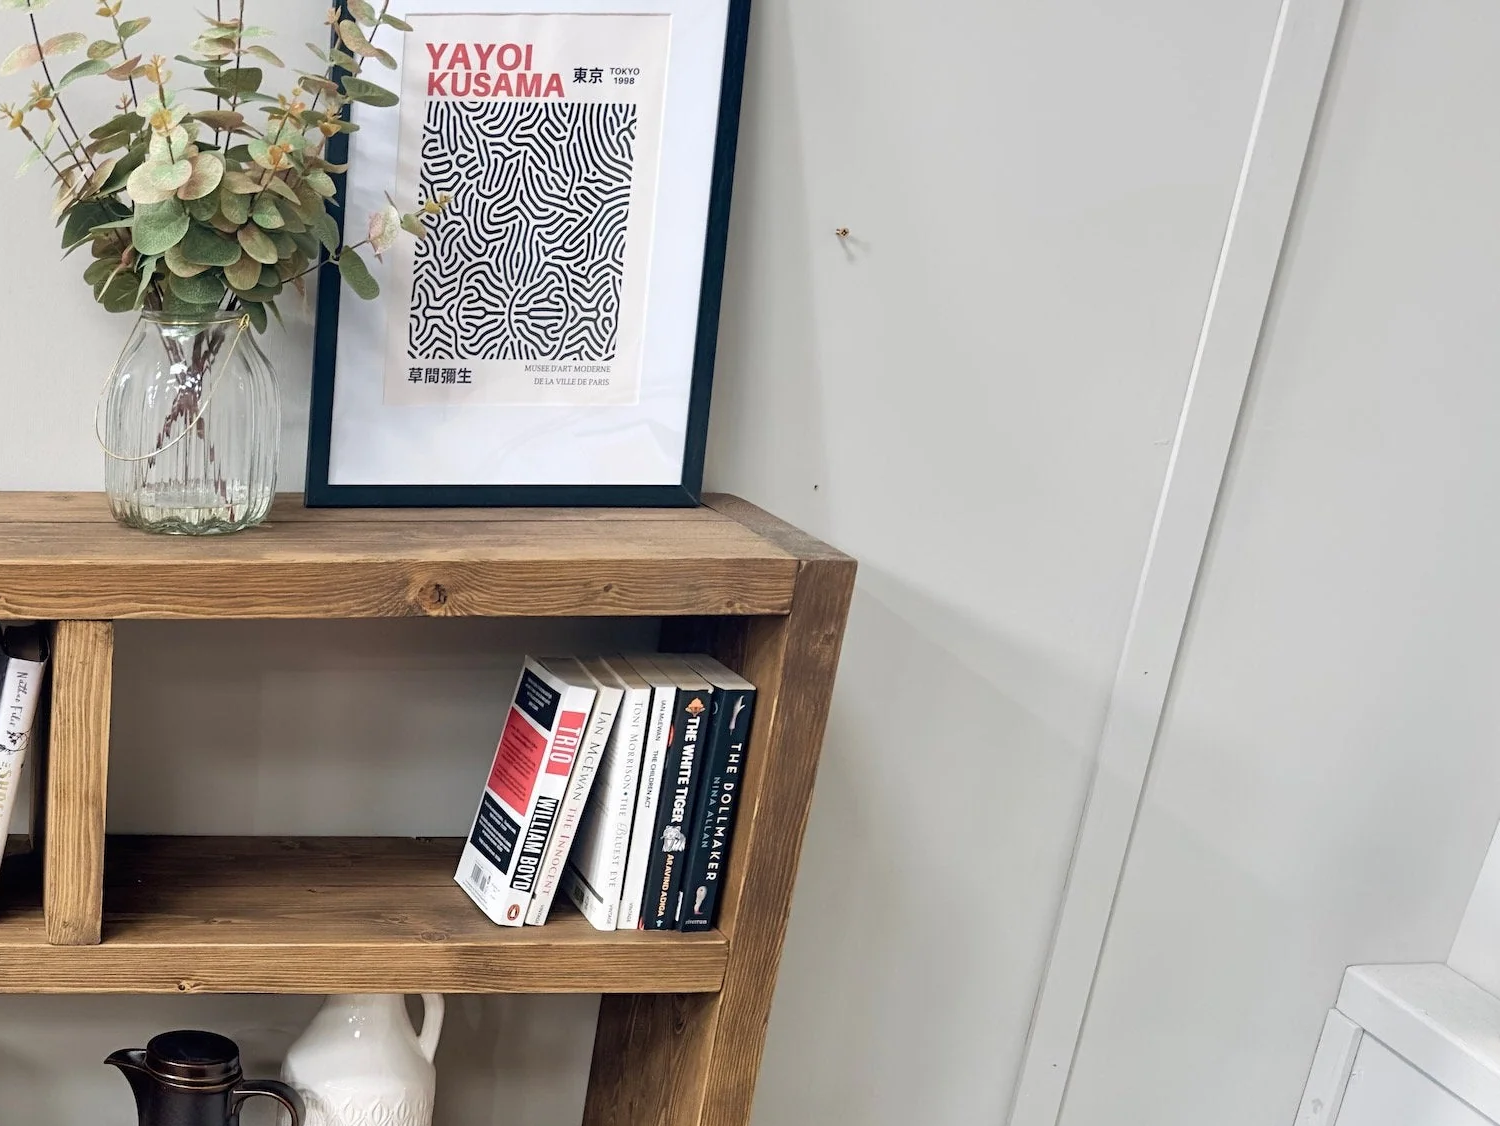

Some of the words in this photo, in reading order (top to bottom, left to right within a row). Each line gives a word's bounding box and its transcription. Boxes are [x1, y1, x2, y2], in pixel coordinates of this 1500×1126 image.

[425, 43, 533, 71] YAYOI
[427, 72, 566, 98] KUSAMA
[572, 67, 604, 84] 東京
[613, 77, 635, 85] 1998
[408, 367, 473, 384] 草間彌生
[551, 365, 572, 373] D'ART
[595, 711, 612, 735] IAN
[632, 703, 643, 727] TONI
[685, 716, 700, 742] THE
[550, 727, 581, 763] TRIO
[651, 750, 659, 762] THE
[726, 743, 742, 774] THE
[623, 734, 638, 790] MORRISON
[677, 744, 696, 785] WHITE
[647, 763, 656, 795] CHILDREN
[709, 776, 721, 806] NINA
[563, 808, 577, 829] THE
[619, 799, 628, 817] THE
[671, 787, 689, 823] TIGER
[524, 799, 557, 854] WILLIAM
[701, 811, 714, 848] ALLAN
[706, 782, 734, 881] DOLLMAKER
[513, 856, 539, 891] BOYD
[543, 834, 570, 895] INNOCENT
[662, 853, 674, 891] ARAVIND
[609, 871, 618, 888] EYE
[657, 891, 668, 917] ADIGA
